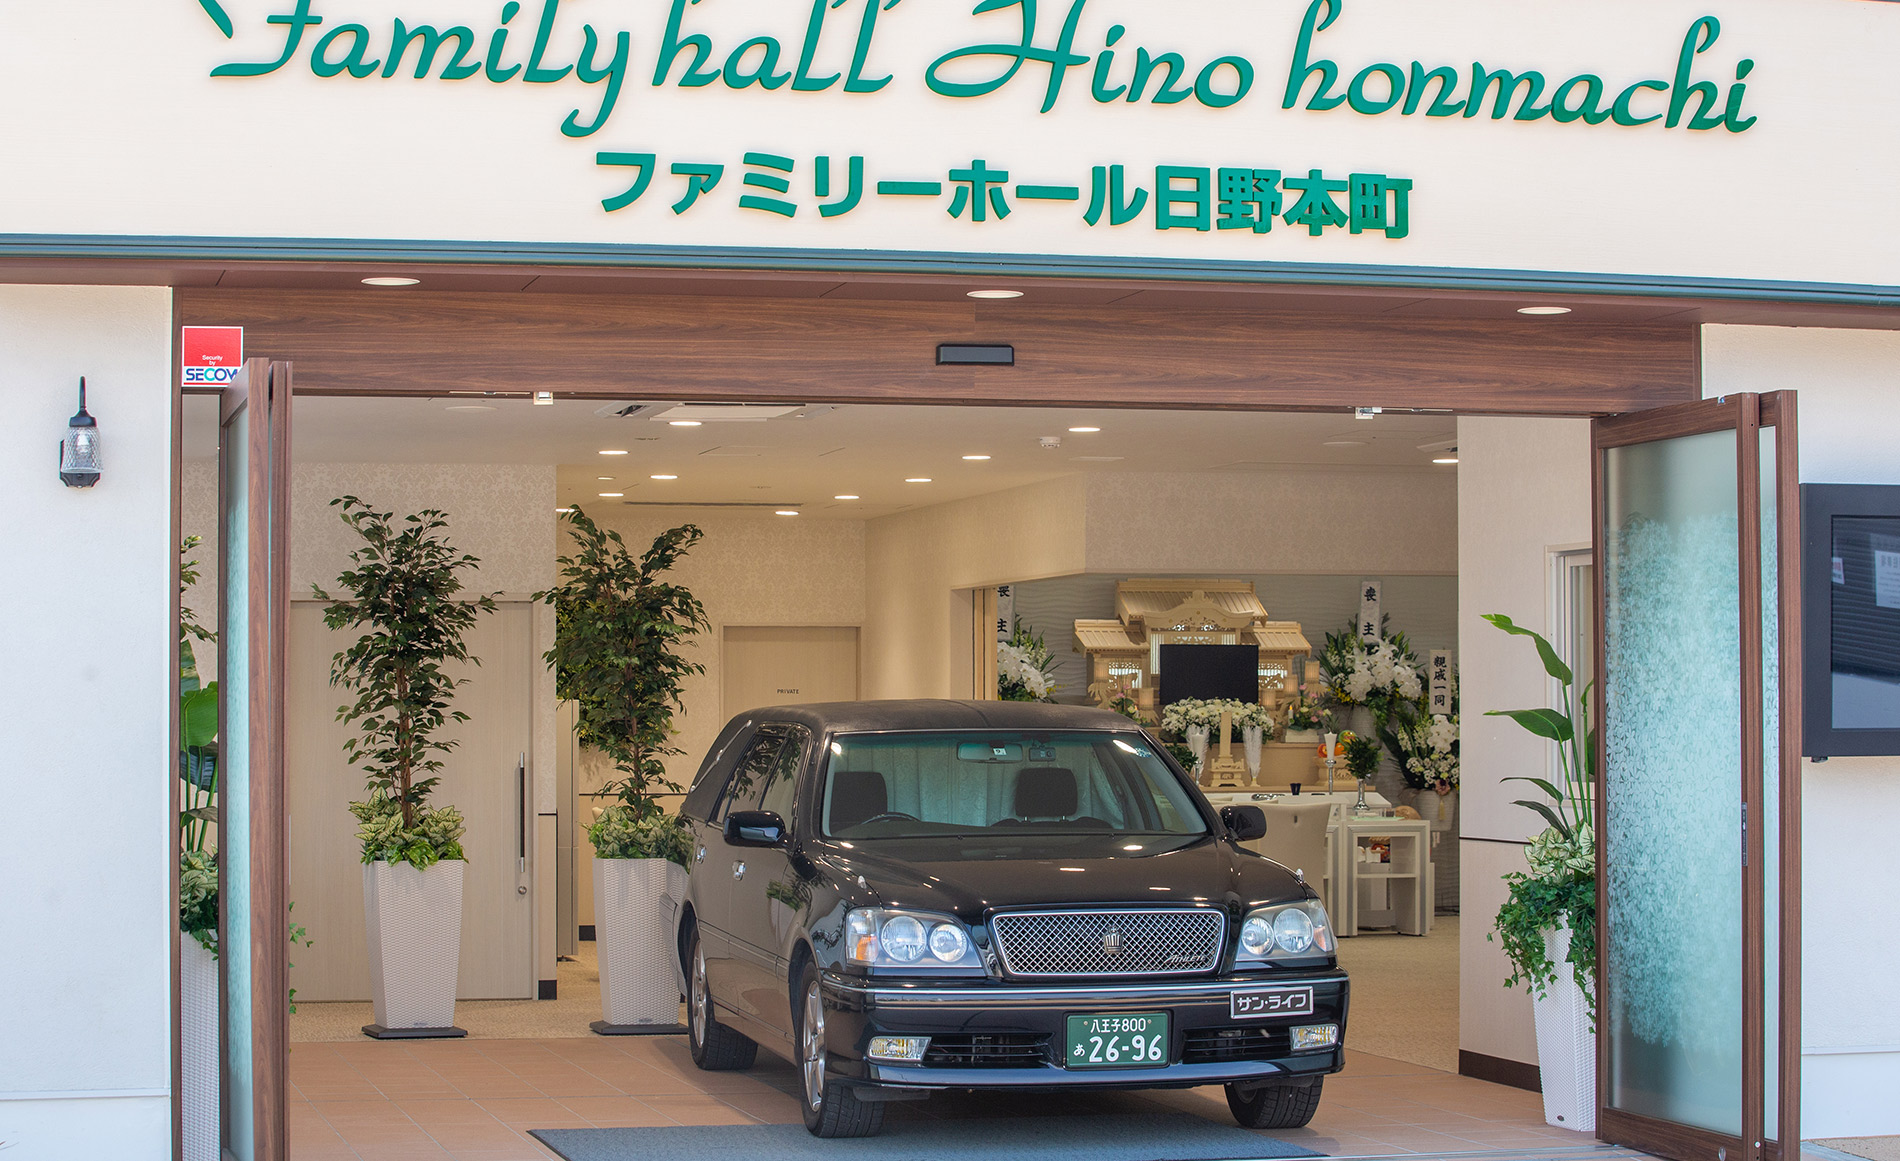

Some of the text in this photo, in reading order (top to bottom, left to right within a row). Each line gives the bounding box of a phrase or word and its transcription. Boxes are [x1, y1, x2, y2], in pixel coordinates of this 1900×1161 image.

[651, 0, 894, 94] hall
[925, 0, 1255, 114] Hino
[1281, 0, 1758, 134] honmachi
[596, 151, 1413, 240] ファミリーホール日野本町
[202, 354, 223, 362] Security
[1363, 586, 1377, 636] 喪主
[1433, 655, 1447, 706] 親戚一同
[1073, 1034, 1162, 1063] あ 26-96
[1090, 1018, 1147, 1033] 八王子800
